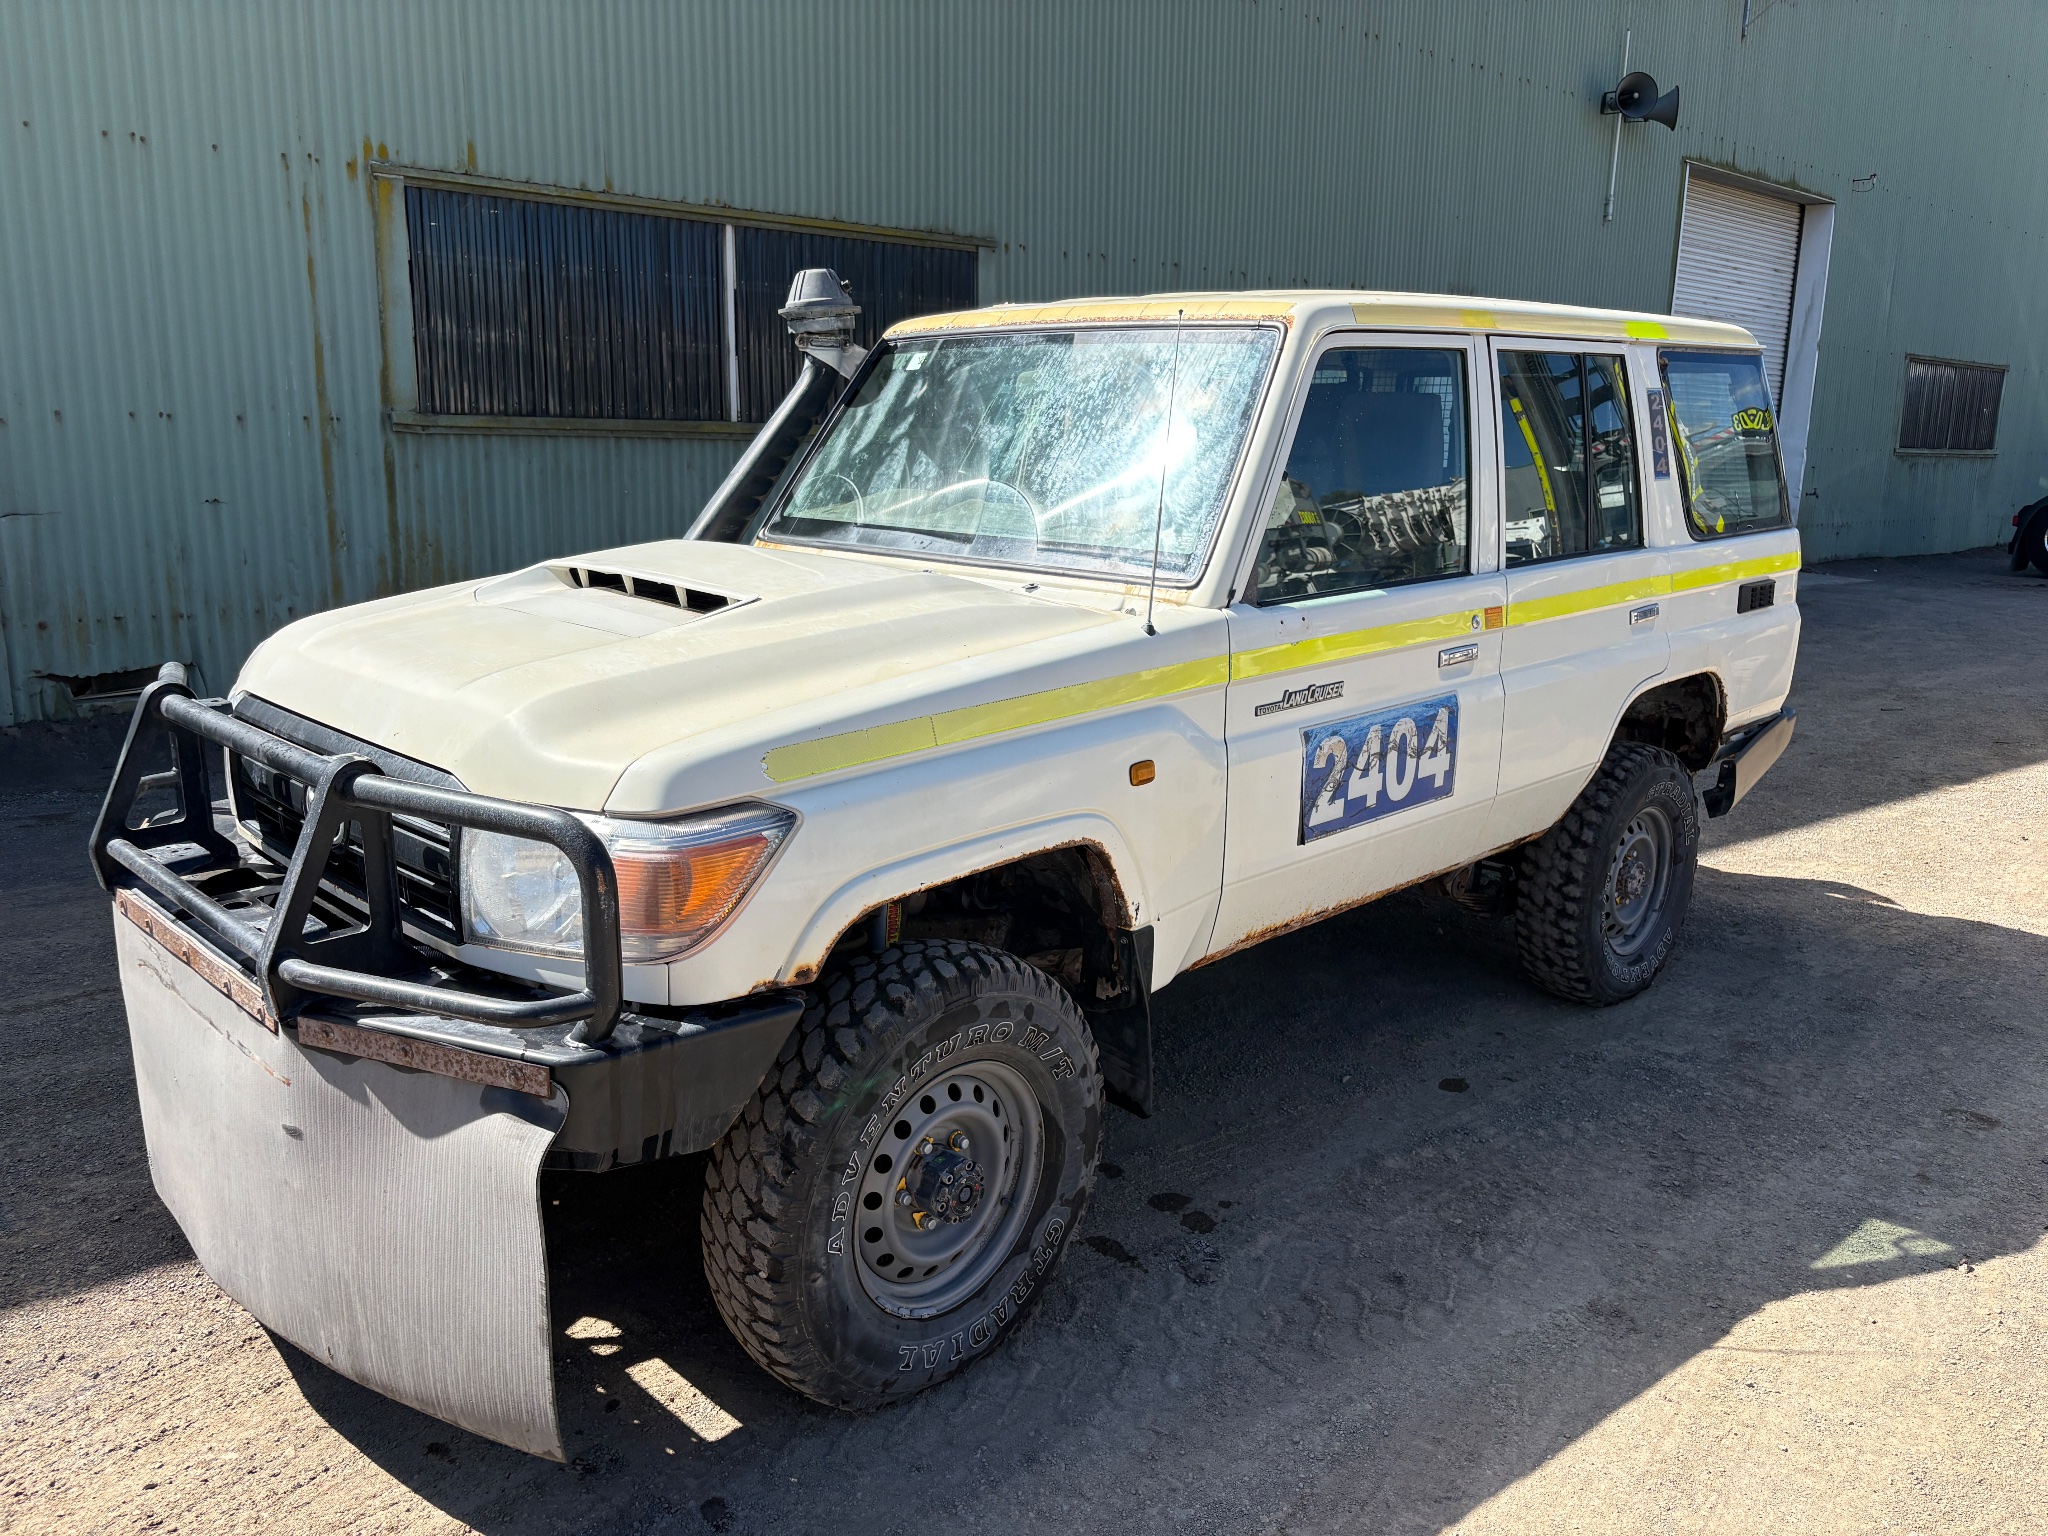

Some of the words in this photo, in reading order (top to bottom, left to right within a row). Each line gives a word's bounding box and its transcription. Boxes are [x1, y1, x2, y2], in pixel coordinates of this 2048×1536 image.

[1650, 393, 1668, 474] 2404
[1258, 703, 1283, 716] TOYOTA
[1308, 707, 1451, 828] 2404
[827, 1021, 1014, 1256] ADVENTURO
[1018, 1026, 1076, 1082] M/T
